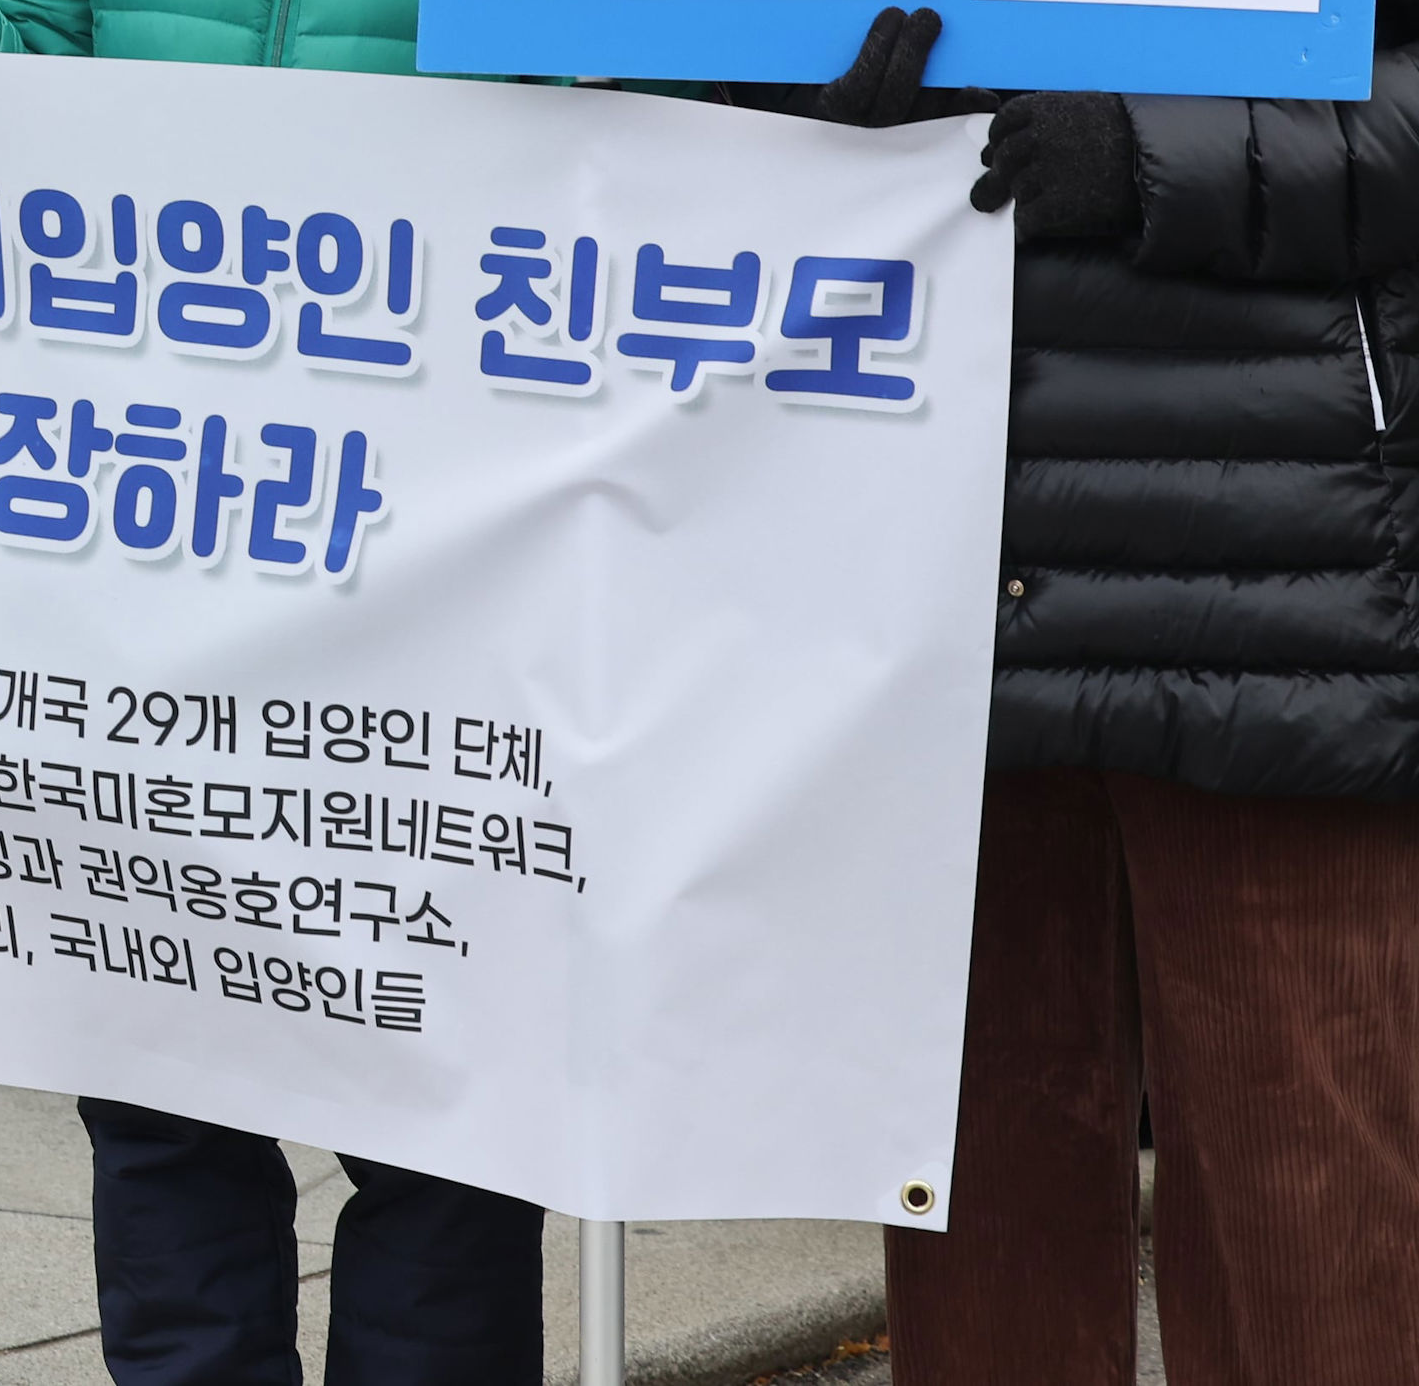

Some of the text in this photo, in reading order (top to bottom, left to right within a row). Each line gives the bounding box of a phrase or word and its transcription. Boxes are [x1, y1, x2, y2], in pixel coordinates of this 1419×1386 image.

[476, 227, 914, 400] 친부모
[107, 687, 236, 753] 29개
[262, 700, 429, 770] 입양인
[455, 717, 551, 797] 단체,
[80, 845, 468, 957] 권익옹호연구소,
[50, 913, 197, 991] 국내외
[214, 947, 425, 1032] 입양인들
